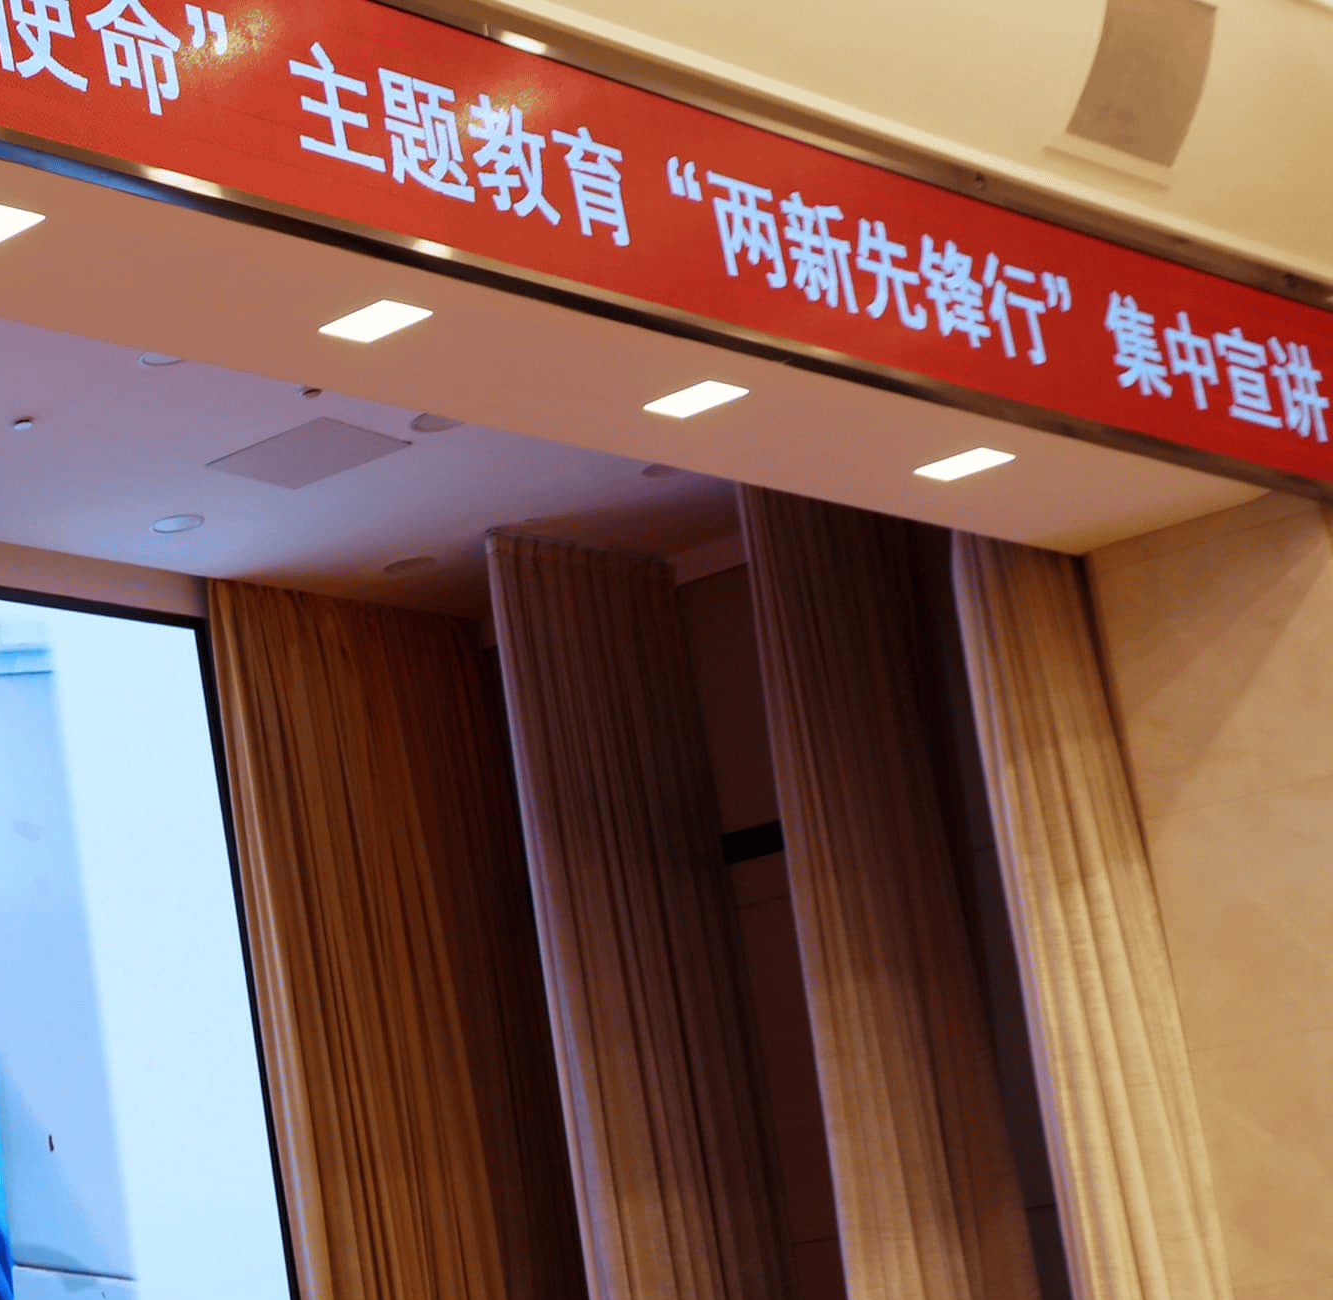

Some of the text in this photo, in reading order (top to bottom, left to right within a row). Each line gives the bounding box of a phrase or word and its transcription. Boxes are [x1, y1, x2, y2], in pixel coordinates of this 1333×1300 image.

[289, 42, 630, 247] 主题教育
[667, 156, 1072, 364] “两新先锋行”
[1104, 291, 1330, 443] 集中宣讲
